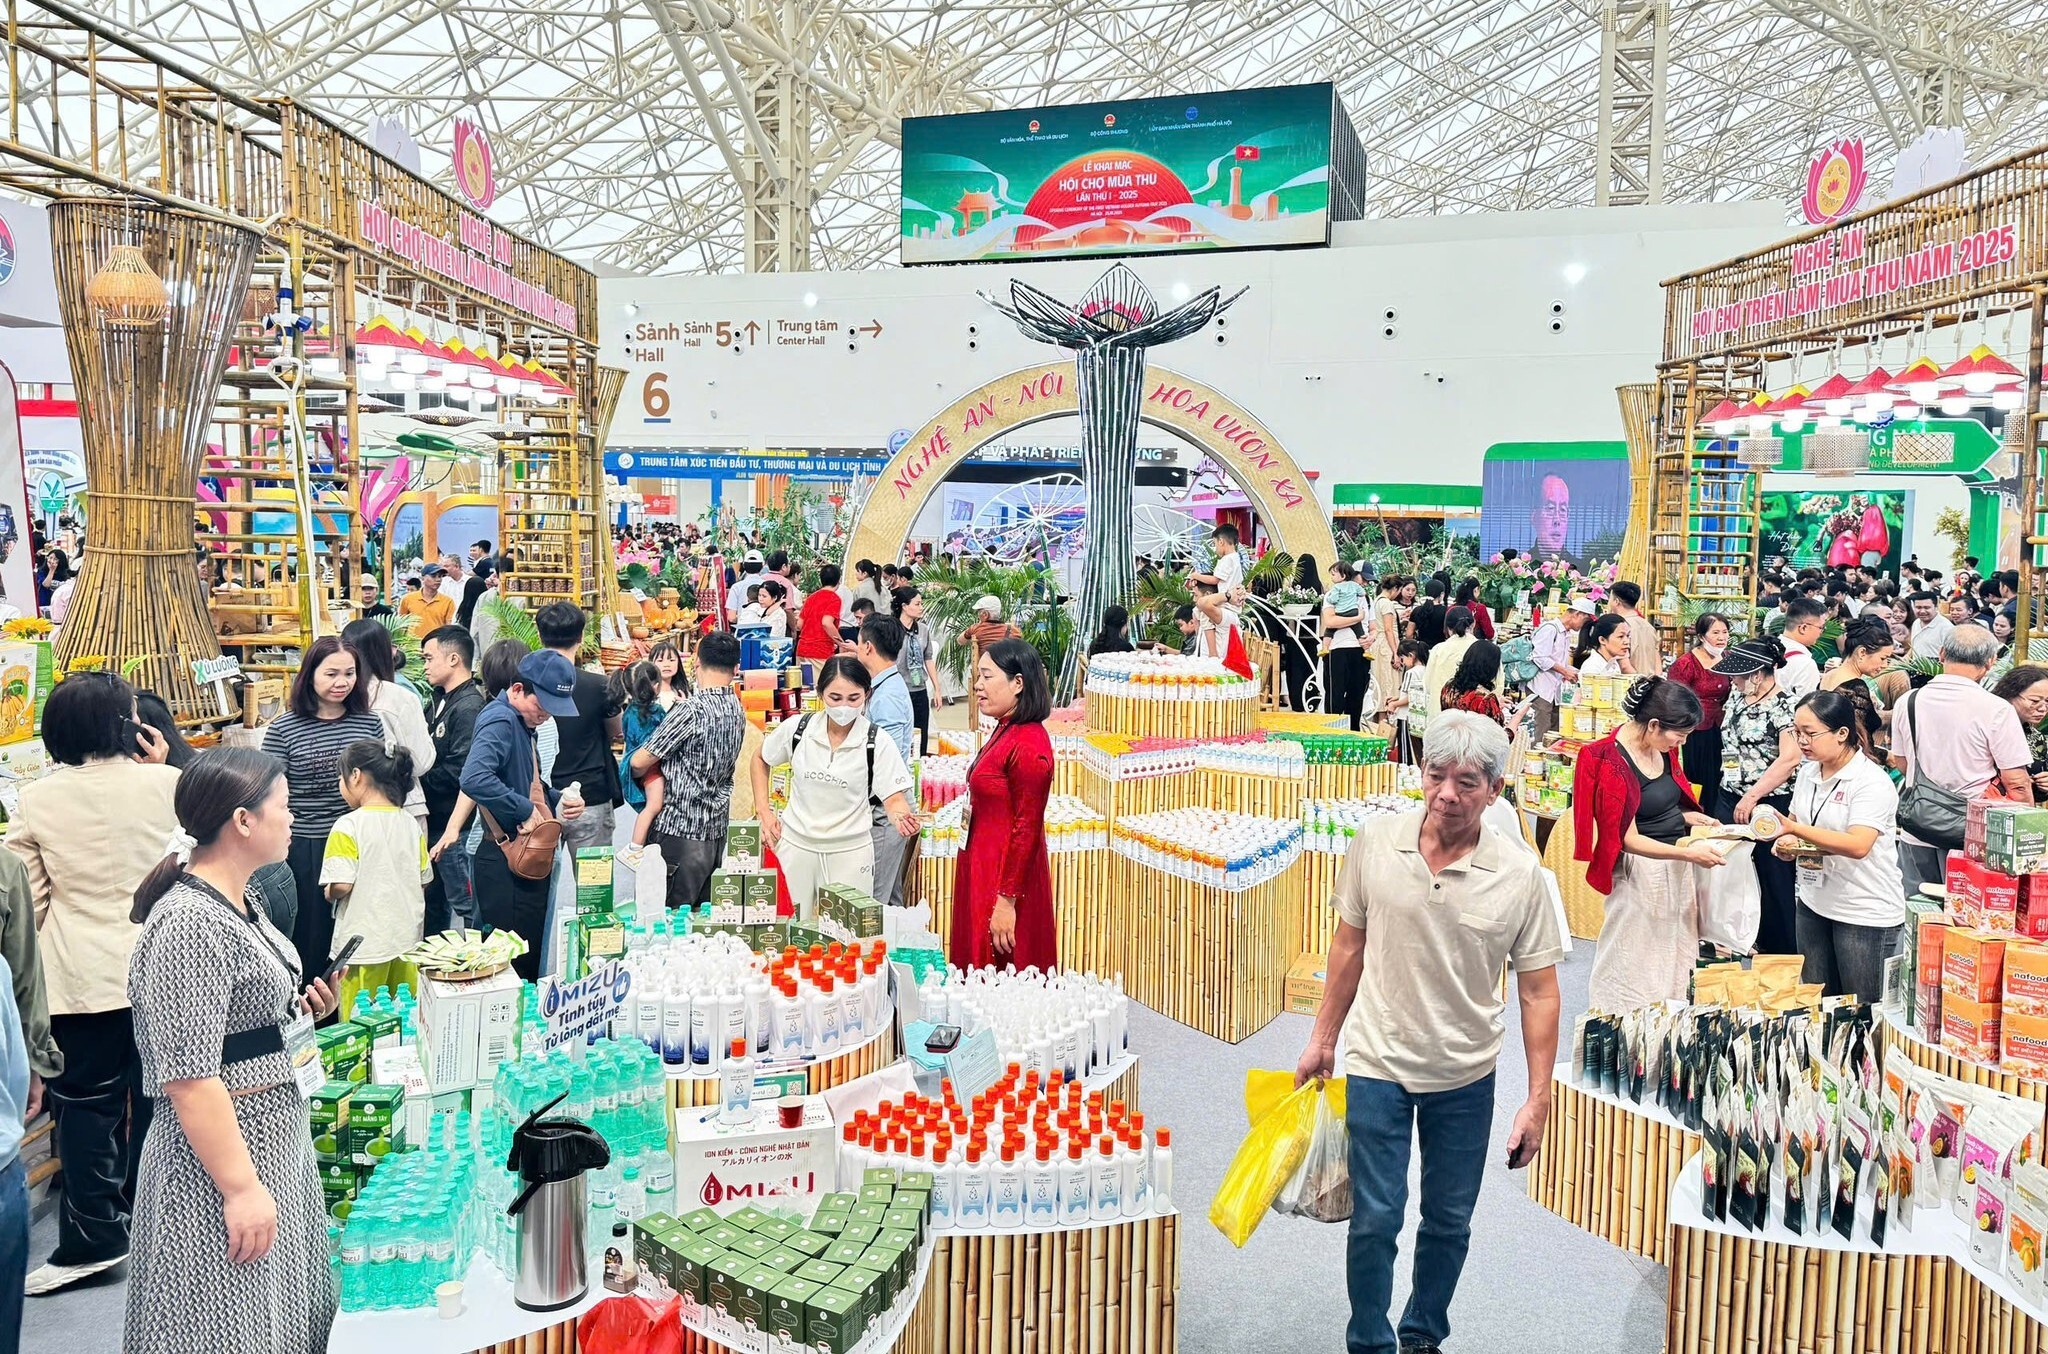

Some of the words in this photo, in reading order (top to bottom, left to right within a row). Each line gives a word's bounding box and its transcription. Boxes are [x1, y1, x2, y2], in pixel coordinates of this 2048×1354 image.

[1083, 160, 1092, 172] LỄ
[1094, 162, 1112, 172] KHAI
[1114, 160, 1132, 171] MẠC
[1059, 176, 1078, 192] HỘI
[1082, 177, 1105, 191] CHỢ
[1108, 174, 1132, 188] MÙA
[1136, 174, 1158, 186] THU
[1118, 190, 1138, 200] 2025
[459, 208, 492, 263] NGHỆ
[494, 226, 512, 267] AN
[1792, 231, 1834, 278] NGHỆ
[1838, 226, 1865, 262] AN
[361, 198, 390, 252] HỘI
[391, 216, 422, 270] CHỢ
[422, 231, 461, 282] TRIỂN
[461, 250, 488, 294] LÃM
[488, 264, 512, 305] MÙA
[512, 275, 532, 314] THU
[532, 286, 555, 324] NĂM
[555, 299, 576, 334] 2025
[1693, 308, 1712, 343] HỘI
[1714, 298, 1742, 339] CHỢ
[1745, 282, 1785, 327] TRIỂN
[1786, 279, 1821, 317] LÃM
[1825, 265, 1862, 308] MÙA
[1864, 259, 1902, 298] THU
[1904, 241, 1952, 288] NĂM
[1958, 224, 2017, 274] 2025
[636, 322, 680, 342] Sảnh
[684, 321, 712, 334] Sảnh
[716, 321, 732, 346] 5
[777, 320, 812, 334] Trung
[815, 320, 838, 331] tâm
[684, 338, 701, 347] Hall
[777, 336, 806, 345] Center
[808, 336, 825, 345] Hall
[636, 348, 664, 362] Hall
[643, 372, 670, 418] 6
[894, 425, 953, 500] NGHỆ
[964, 395, 994, 433] AN
[1018, 372, 1064, 406] NƠI
[1010, 442, 1044, 458] PHÁT
[1148, 383, 1210, 420] HOA
[1213, 414, 1280, 470] VƯƠN
[1270, 478, 1304, 508] XA
[640, 457, 668, 467] TRUNG
[670, 456, 688, 467] TÂM
[690, 456, 707, 468] XÚC
[710, 457, 727, 468] TIẾN
[748, 459, 761, 470] TƯ,
[763, 460, 795, 470] THƯƠNG
[798, 461, 814, 471] MẠI
[816, 460, 827, 470] VÀ
[829, 462, 840, 471] DU
[842, 462, 860, 472] LỊCH
[862, 460, 881, 471] TỈNH
[588, 994, 606, 1011] túy
[545, 1032, 558, 1050] Từ
[560, 1023, 584, 1042] lòng
[605, 1006, 620, 1018] mẹ
[363, 1114, 376, 1122] MĂNG
[740, 1145, 758, 1154] CÔNG
[760, 1143, 777, 1153] NGHỆ
[778, 1142, 795, 1152] NHẬT
[796, 1140, 810, 1149] BẢN
[722, 1152, 793, 1166] アルカリイオンの水
[330, 1176, 341, 1185] MĂNG
[342, 1177, 352, 1185] TÂY
